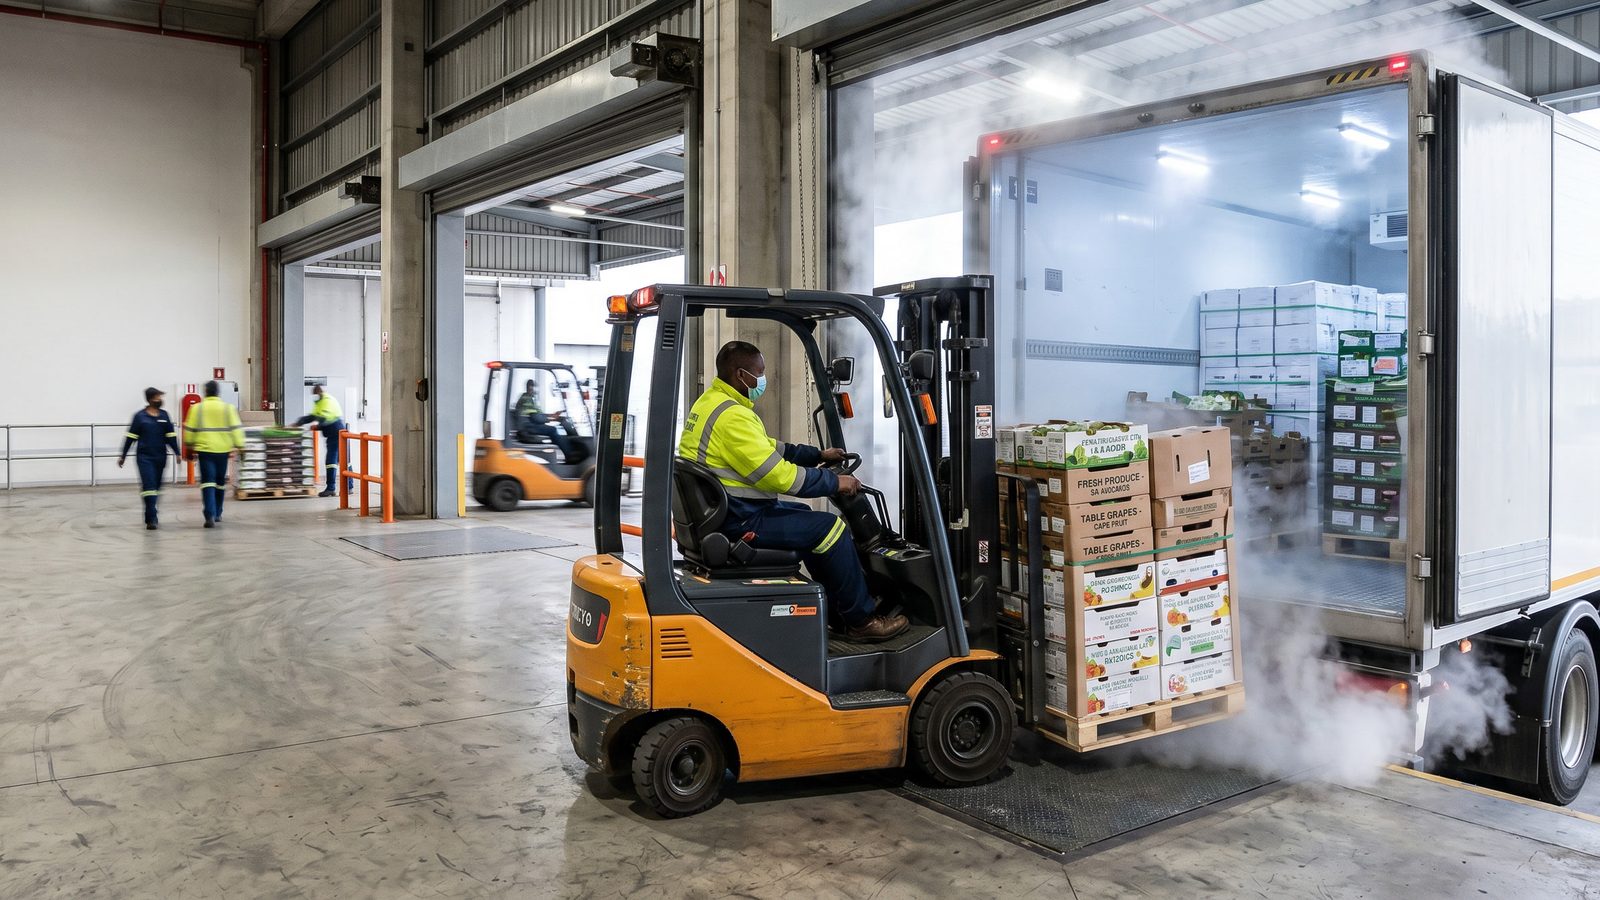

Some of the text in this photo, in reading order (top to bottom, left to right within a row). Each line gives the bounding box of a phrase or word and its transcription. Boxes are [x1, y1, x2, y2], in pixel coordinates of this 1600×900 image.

[1078, 478, 1103, 489] FRESH
[1105, 472, 1140, 485] PRODUCE
[1091, 488, 1099, 496] SA
[1081, 512, 1105, 523] TABLE
[1107, 507, 1138, 519] GRAPES
[1093, 522, 1110, 530] CAPE
[1083, 544, 1108, 556] TABLE
[1110, 539, 1140, 552] GRAPES
